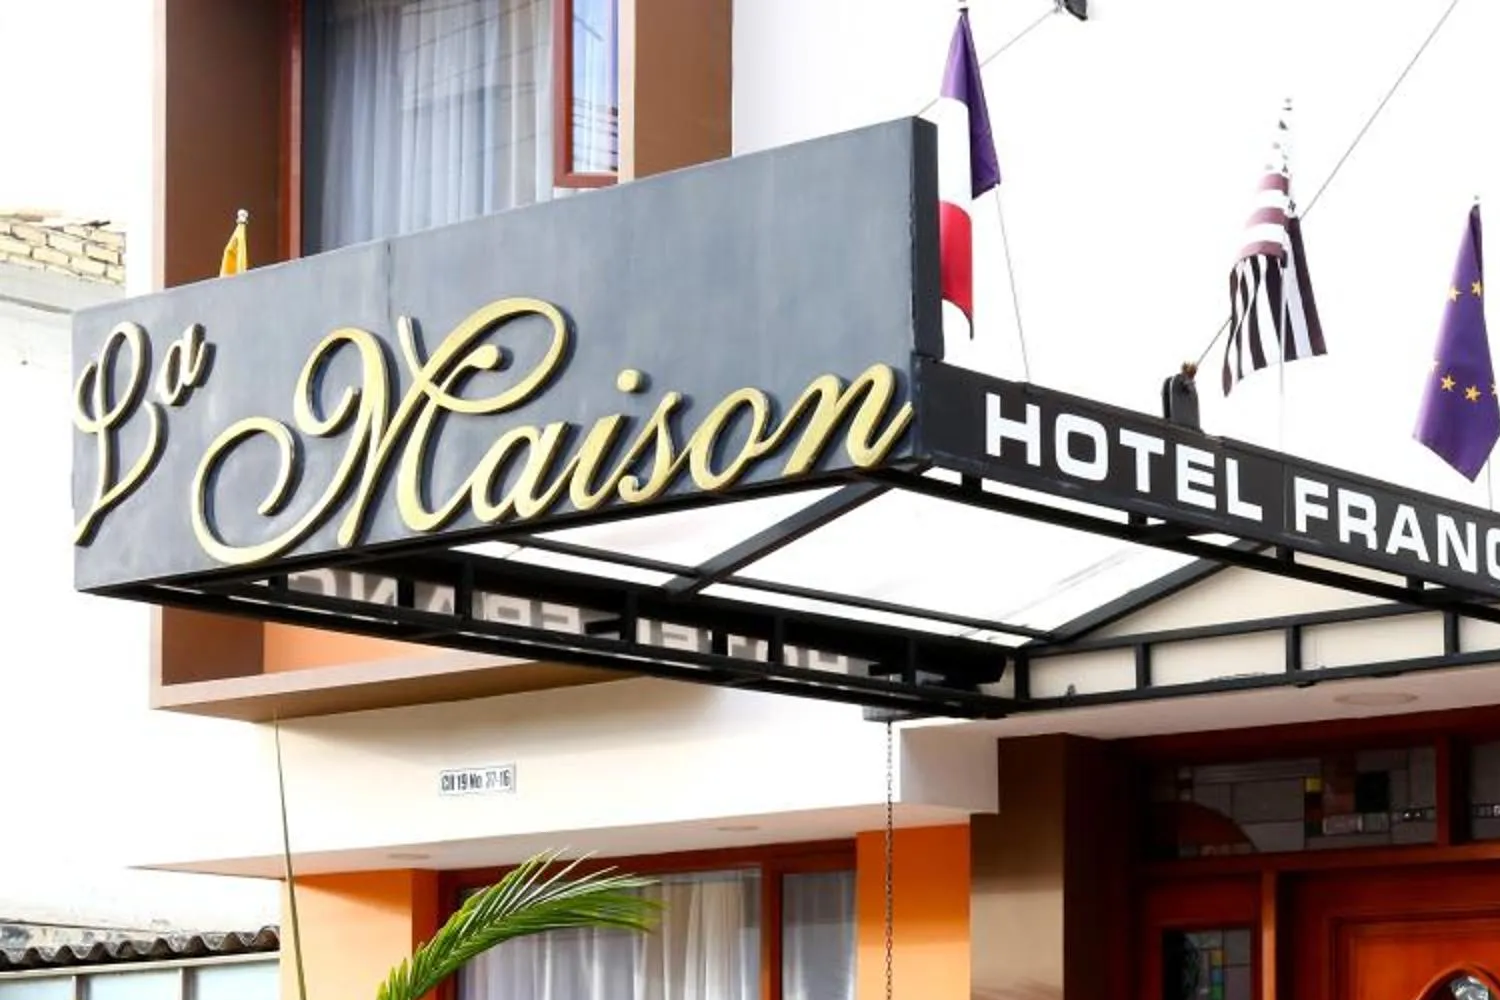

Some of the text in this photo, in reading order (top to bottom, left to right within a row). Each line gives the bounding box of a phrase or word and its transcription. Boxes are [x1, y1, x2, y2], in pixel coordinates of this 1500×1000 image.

[72, 296, 915, 565] La Maison
[984, 391, 1264, 522] HOTEL
